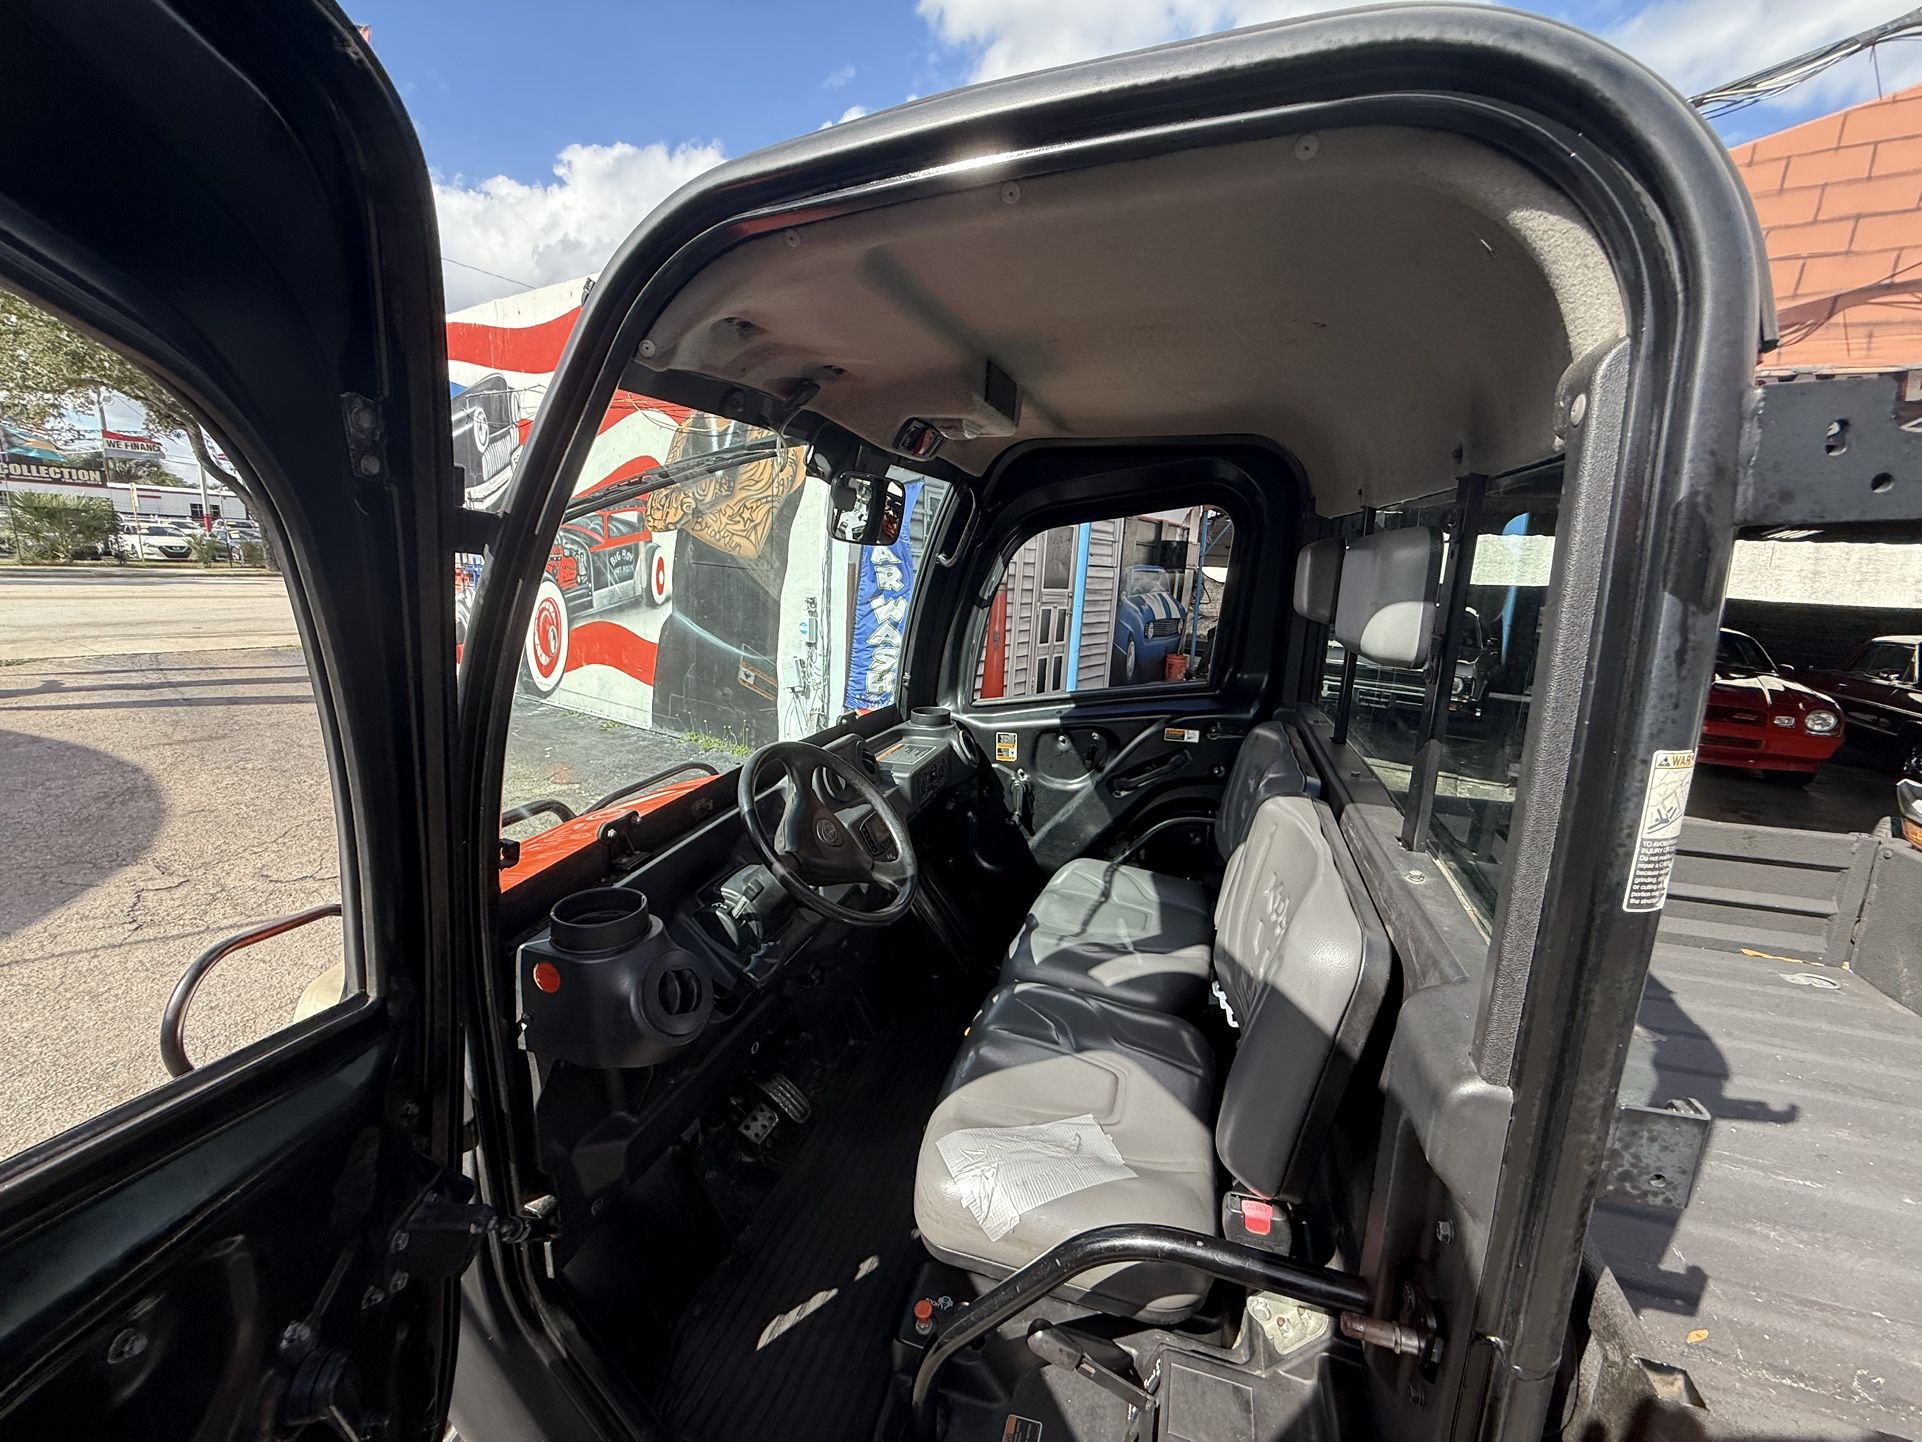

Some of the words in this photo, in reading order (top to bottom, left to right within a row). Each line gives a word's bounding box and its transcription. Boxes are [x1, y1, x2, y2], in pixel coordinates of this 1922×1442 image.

[106, 440, 122, 448] WE
[0, 463, 101, 481] COLLECTION
[609, 551, 621, 566] BIG
[621, 549, 634, 562] BOY
[870, 545, 905, 591] AR
[865, 594, 909, 695] WASH
